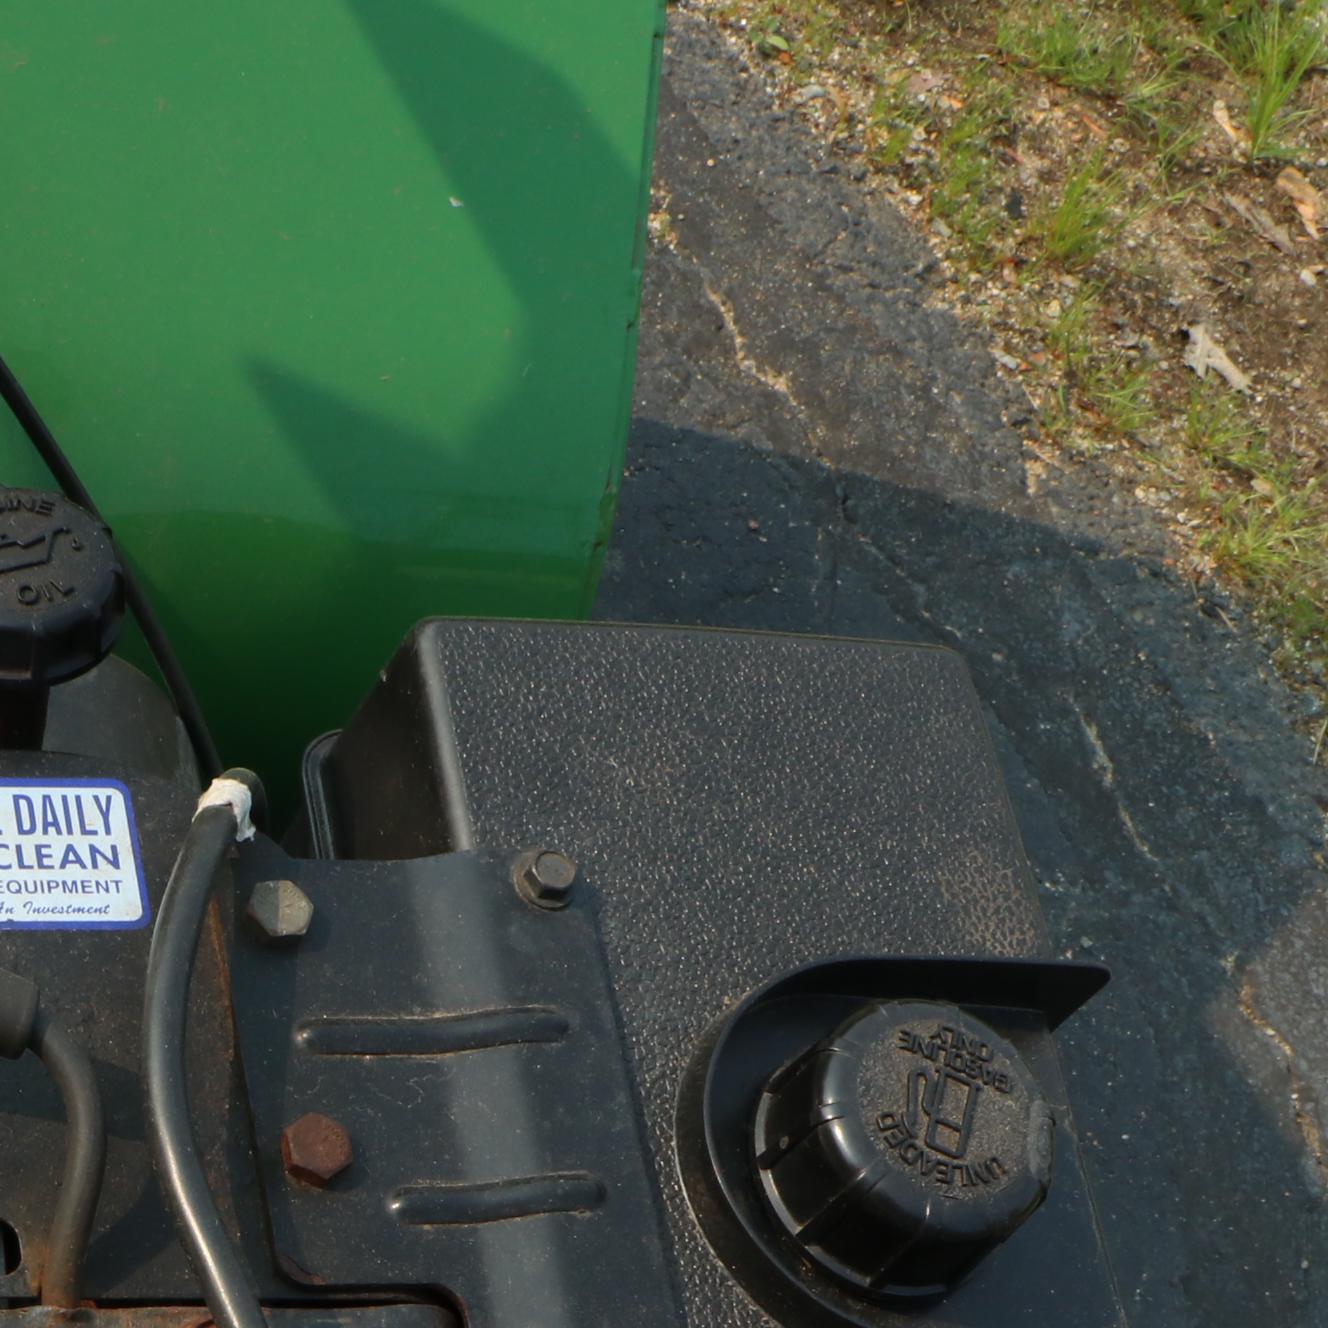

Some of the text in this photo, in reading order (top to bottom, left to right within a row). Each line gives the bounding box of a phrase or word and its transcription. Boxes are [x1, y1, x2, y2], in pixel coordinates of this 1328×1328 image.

[17, 579, 74, 605] OIL
[12, 793, 113, 836] DAILY
[22, 901, 111, 915] Investment
[896, 1030, 1013, 1094] GASOLINE
[927, 1025, 994, 1063] ONLY
[875, 1111, 1008, 1187] UNLEADED
